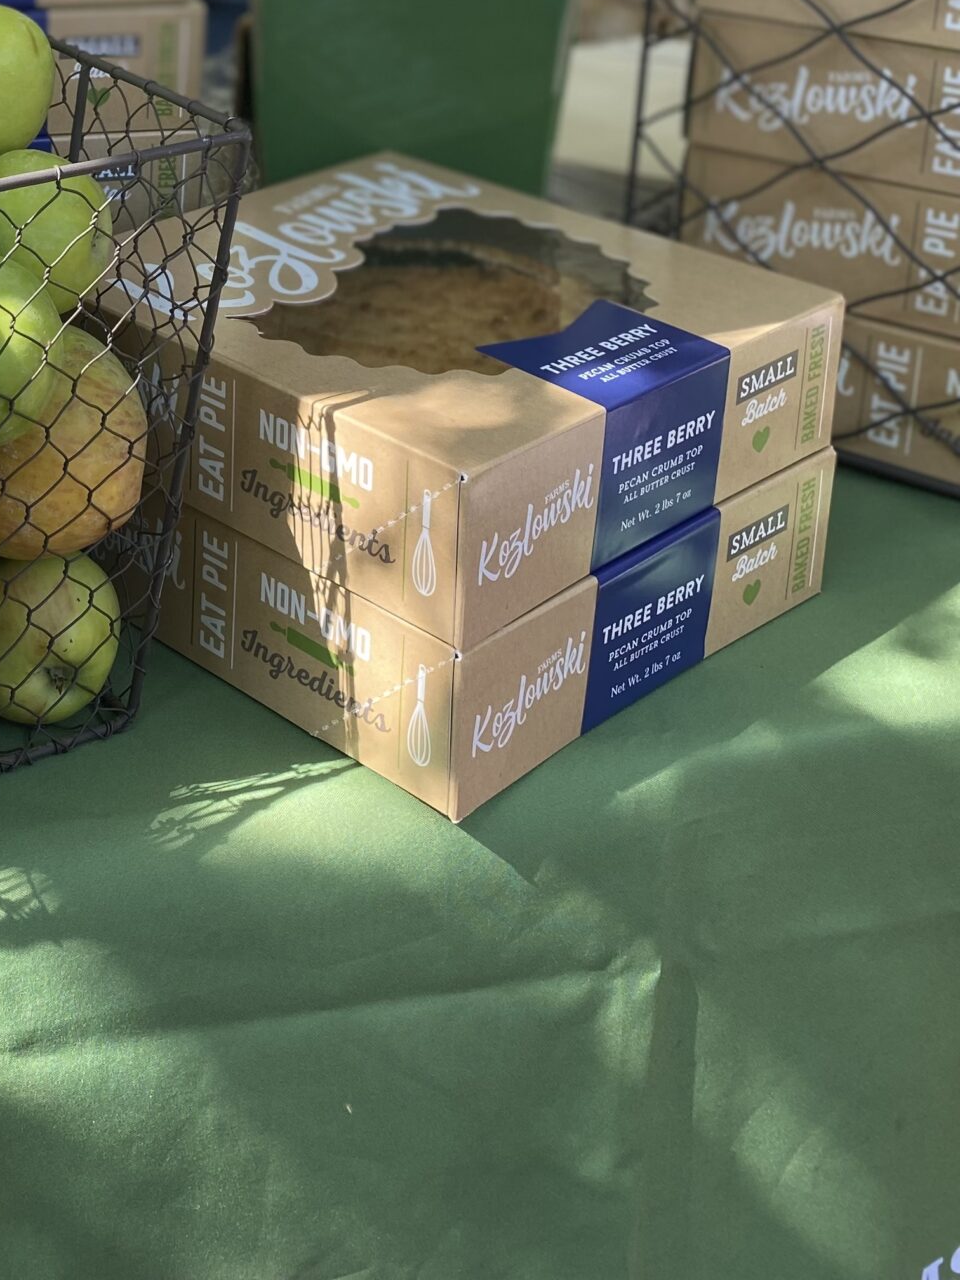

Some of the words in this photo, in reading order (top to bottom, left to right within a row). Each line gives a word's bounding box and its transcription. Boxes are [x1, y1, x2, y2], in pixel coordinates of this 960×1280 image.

[923, 208, 960, 258] PIE
[540, 346, 604, 375] THREE
[605, 323, 658, 352] BERRY
[578, 362, 615, 381] PECAN
[615, 347, 650, 366] CRUMB
[649, 338, 670, 351] TOP
[600, 371, 620, 383] ALL
[619, 357, 651, 377] BUTTER
[651, 346, 678, 362] CRUST
[740, 356, 795, 398] SMALL
[808, 324, 825, 383] FRESH
[200, 375, 227, 432] PIE
[741, 387, 787, 426] Batch
[801, 384, 819, 445] BAKED
[198, 434, 225, 503] EAT
[259, 408, 373, 492] NON-GMO
[612, 436, 662, 475] THREE
[666, 410, 716, 446] BERRY
[618, 470, 649, 494] PECAN
[651, 454, 684, 478] CRUMB
[685, 444, 704, 462] TOP
[544, 479, 570, 505] FARMS
[620, 516, 637, 531] Net
[638, 507, 653, 522] Wt.
[654, 503, 661, 514] 2
[662, 496, 674, 511] lbs
[675, 492, 682, 503] 7
[682, 489, 692, 500] oz
[623, 489, 639, 504] ALL
[640, 475, 670, 497] BUTTER
[671, 462, 695, 482] CRUST
[799, 477, 816, 535] FRESH
[240, 469, 396, 564] Ingredients
[478, 463, 594, 586] Kozlowski
[730, 511, 785, 556] SMALL
[202, 530, 229, 592] PIE
[731, 541, 778, 582] Batch
[792, 536, 810, 594] BAKED
[200, 592, 226, 659] EAT
[260, 571, 371, 662] NON-GMO
[603, 603, 653, 645] THREE
[656, 574, 705, 616] BERRY
[608, 638, 639, 663] PECAN
[640, 619, 673, 643] CRUMB
[674, 607, 693, 625] TOP
[537, 647, 563, 675] FARMS
[610, 683, 626, 698] Net
[627, 673, 642, 688] Wt.
[644, 667, 650, 678] 2
[651, 660, 664, 675] lbs
[665, 655, 671, 666] 7
[671, 651, 681, 662] oz
[613, 656, 629, 671] ALL
[629, 639, 659, 664] BUTTER
[660, 625, 685, 645] CRUST
[241, 630, 392, 733] Ingredients
[471, 630, 589, 758] Kozlowski
